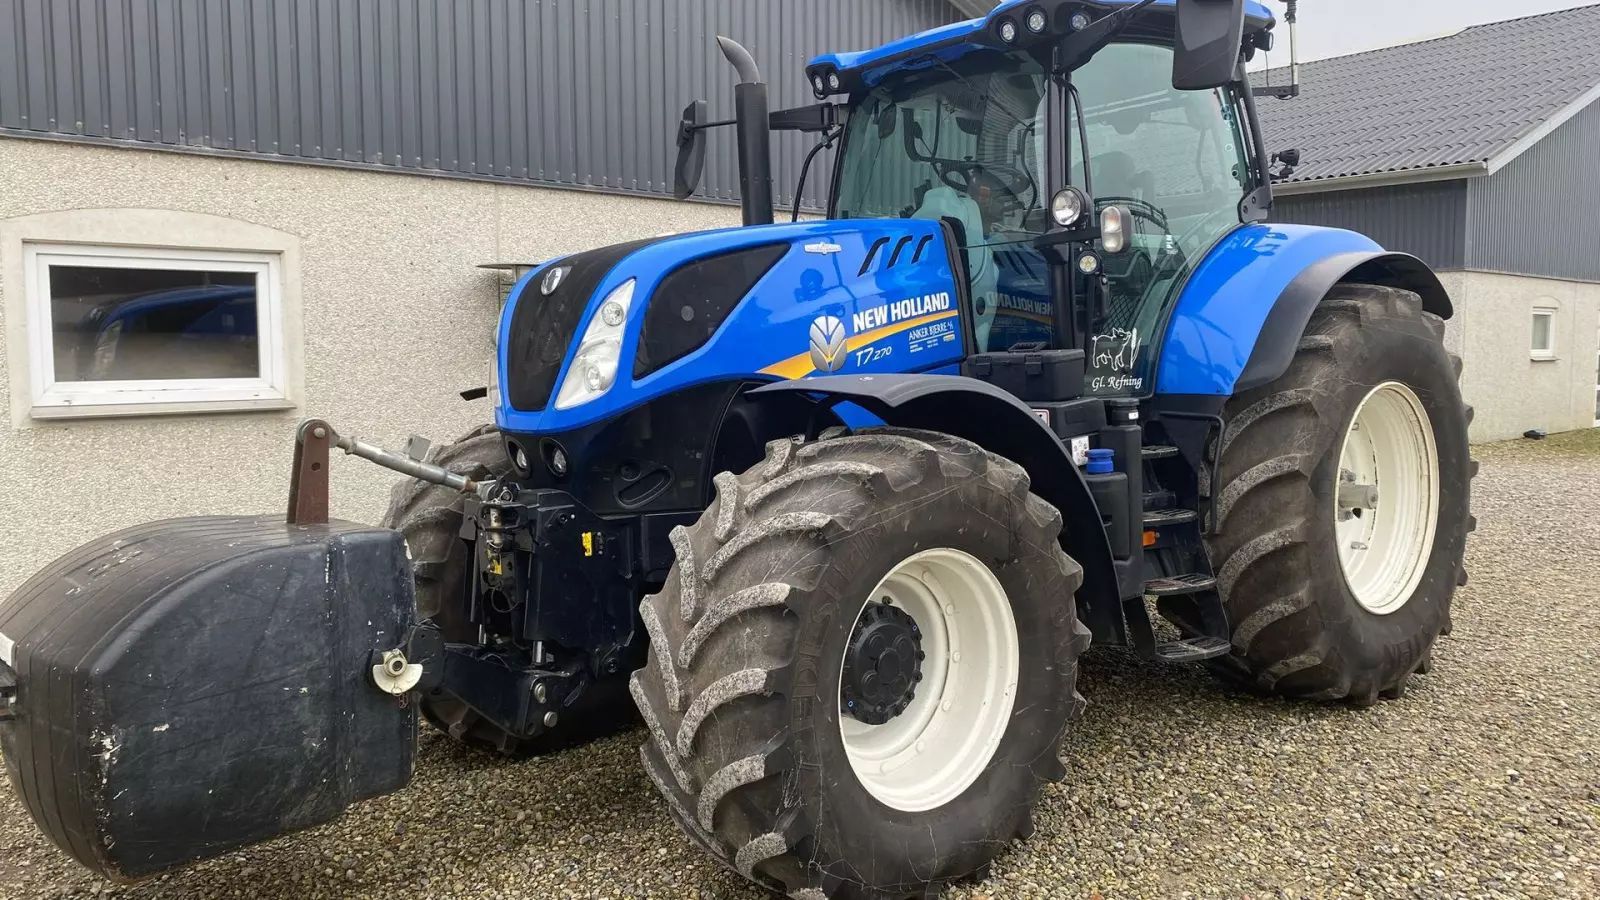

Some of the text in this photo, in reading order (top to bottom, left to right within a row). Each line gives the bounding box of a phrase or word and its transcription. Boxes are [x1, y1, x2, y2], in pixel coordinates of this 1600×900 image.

[853, 291, 950, 333] NEW HOLLAND
[908, 327, 929, 341] ANKER
[1091, 374, 1143, 391] Gl. Refning
